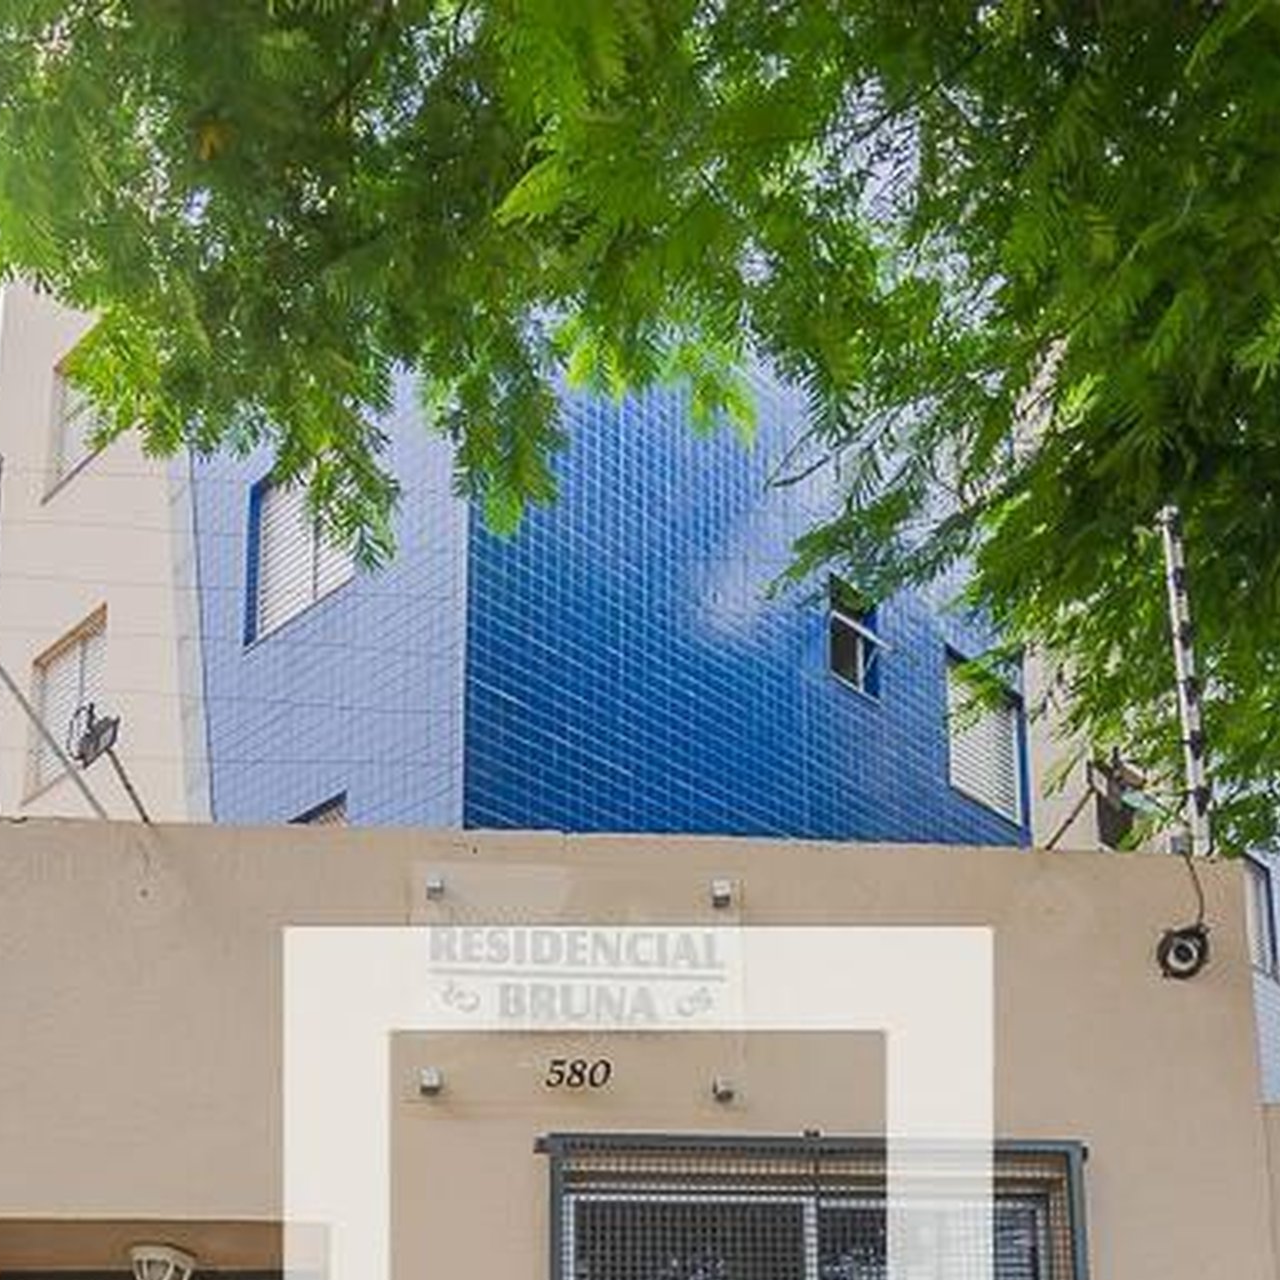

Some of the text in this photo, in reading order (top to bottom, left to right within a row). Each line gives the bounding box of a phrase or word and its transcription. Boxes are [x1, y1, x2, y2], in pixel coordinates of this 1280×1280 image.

[429, 930, 725, 969] RESIDENCIAL
[498, 984, 660, 1022] BRUNA
[545, 1059, 611, 1088] 580
